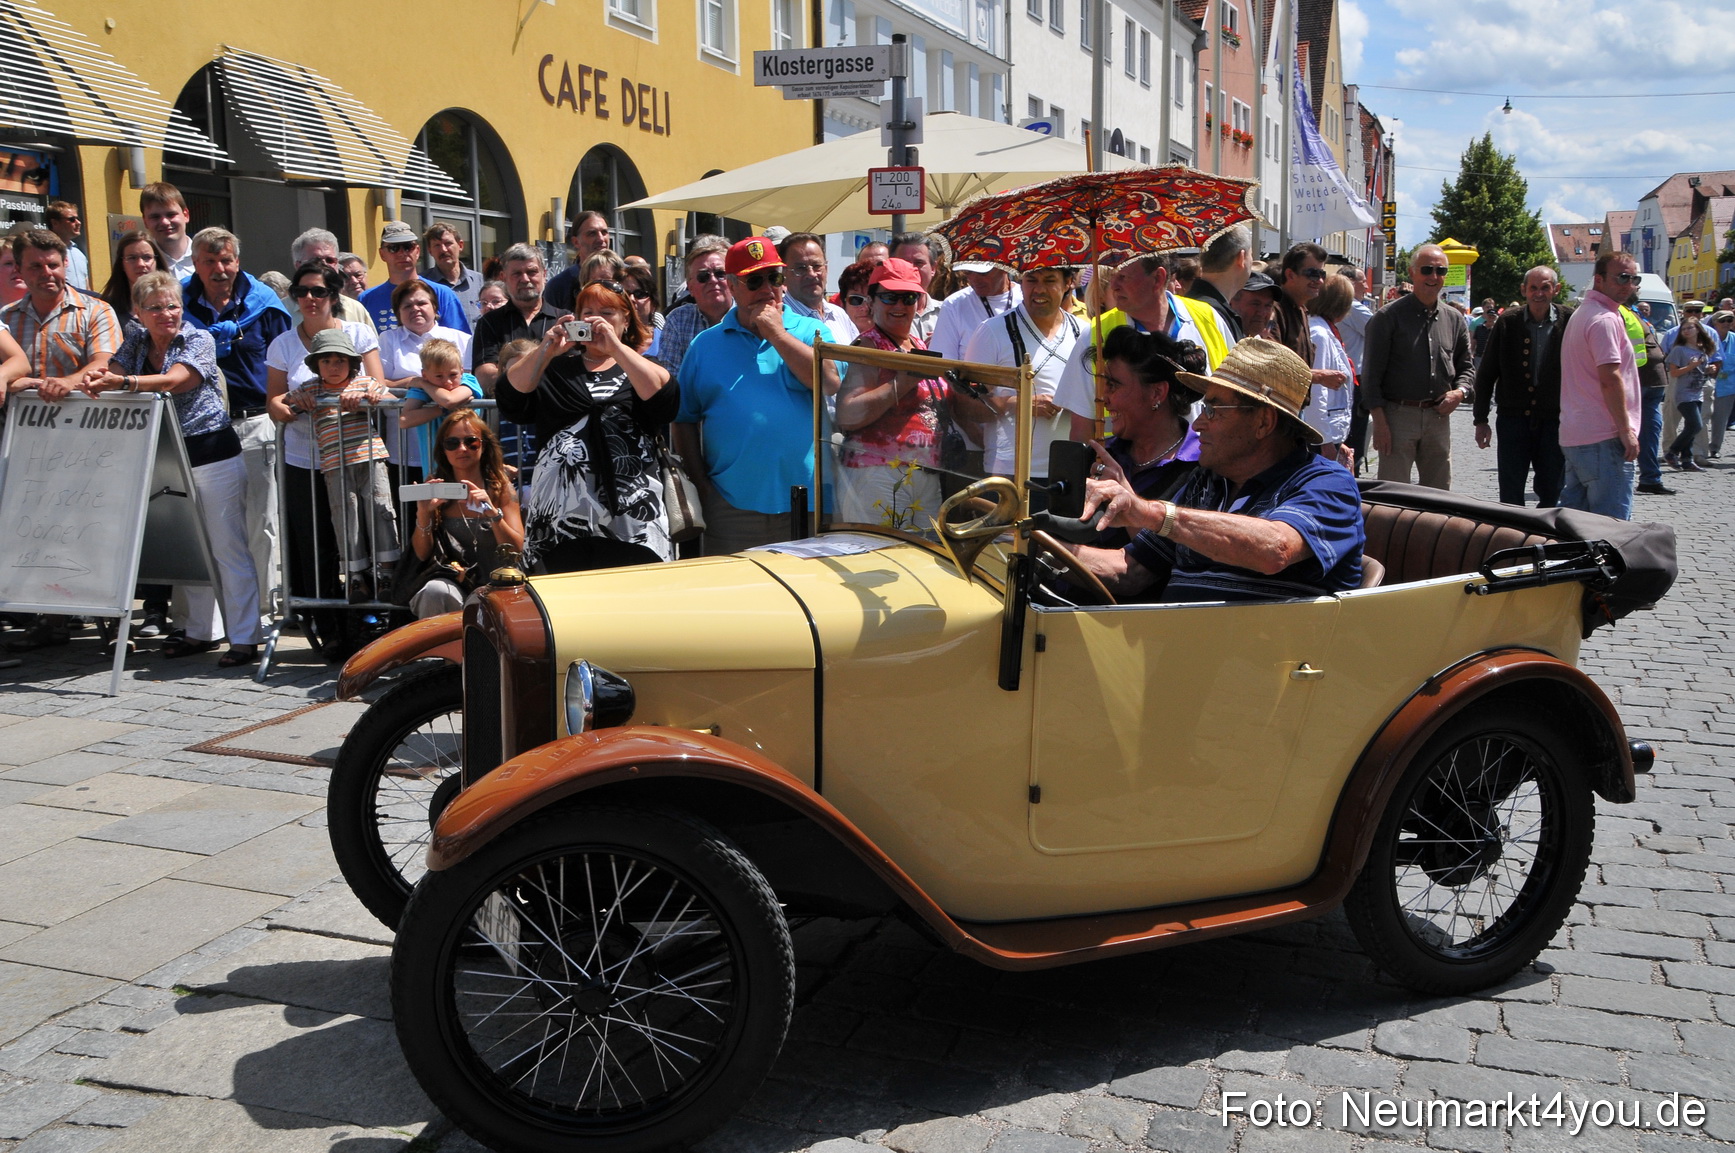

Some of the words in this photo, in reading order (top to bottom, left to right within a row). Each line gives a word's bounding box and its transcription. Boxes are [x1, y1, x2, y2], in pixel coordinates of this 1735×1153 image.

[762, 55, 874, 80] Klostergasse
[538, 54, 609, 119] CAFE
[621, 77, 671, 136] DELI
[875, 173, 882, 182] H
[890, 172, 910, 182] 200
[881, 198, 902, 209] 24,0
[905, 186, 919, 197] 0,2
[0, 198, 45, 213] Passbilder
[1296, 203, 1326, 213] 2011
[1383, 203, 1396, 270] HOTEL
[18, 405, 62, 429] ILIK
[79, 407, 151, 431] IMBISS
[25, 440, 114, 475] Heute
[22, 478, 106, 509] Frische
